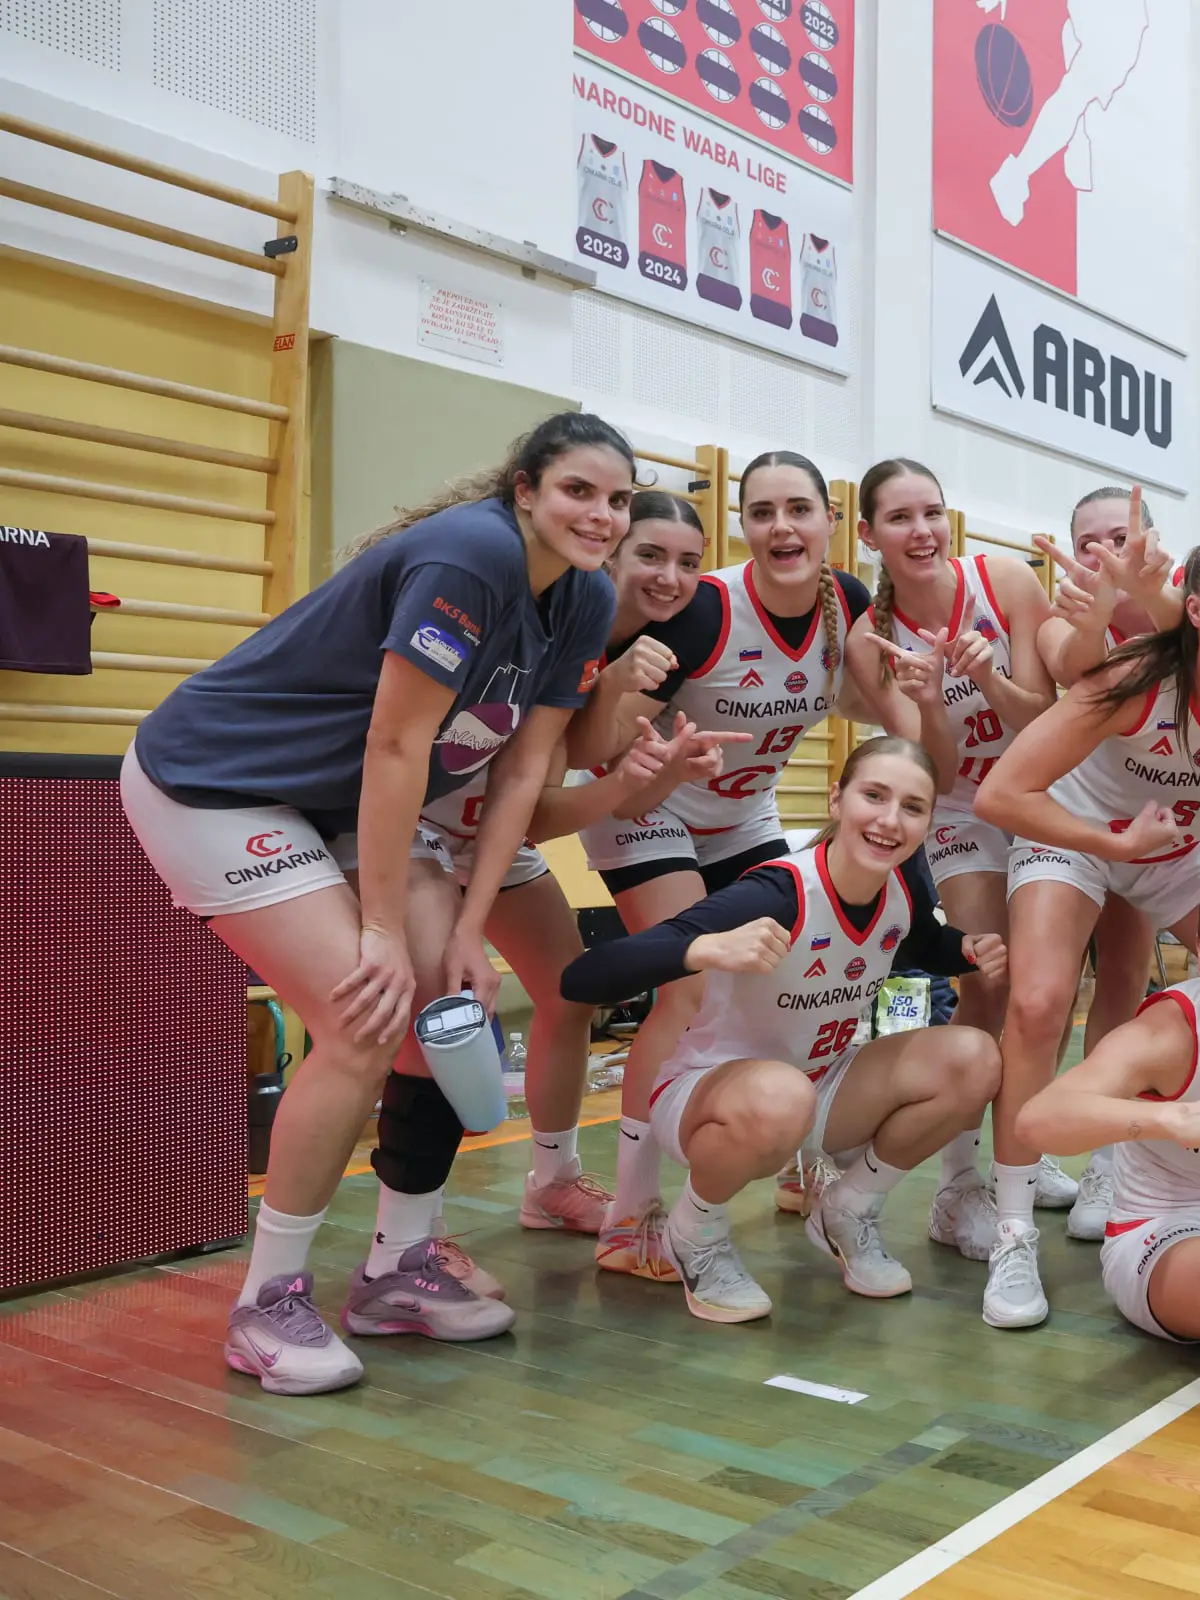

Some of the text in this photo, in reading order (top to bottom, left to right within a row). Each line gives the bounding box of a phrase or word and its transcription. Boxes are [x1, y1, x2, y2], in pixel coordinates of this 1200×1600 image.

[804, 12, 834, 40] 2022
[682, 126, 740, 173] WABA
[746, 158, 787, 194] LIGE
[583, 235, 622, 262] 2023
[645, 259, 682, 285] 2024
[274, 335, 295, 350] ELAN
[1033, 323, 1172, 449] ARDU
[432, 596, 461, 619] BKS
[715, 697, 808, 719] CINKARNA
[754, 725, 804, 756] 13
[615, 827, 688, 846] CINKARNA
[224, 847, 330, 886] CINKARNA
[777, 984, 863, 1011] CINKARNA
[892, 995, 913, 1007] ISO
[887, 1005, 919, 1018] PLUS
[808, 1018, 859, 1060] 26
